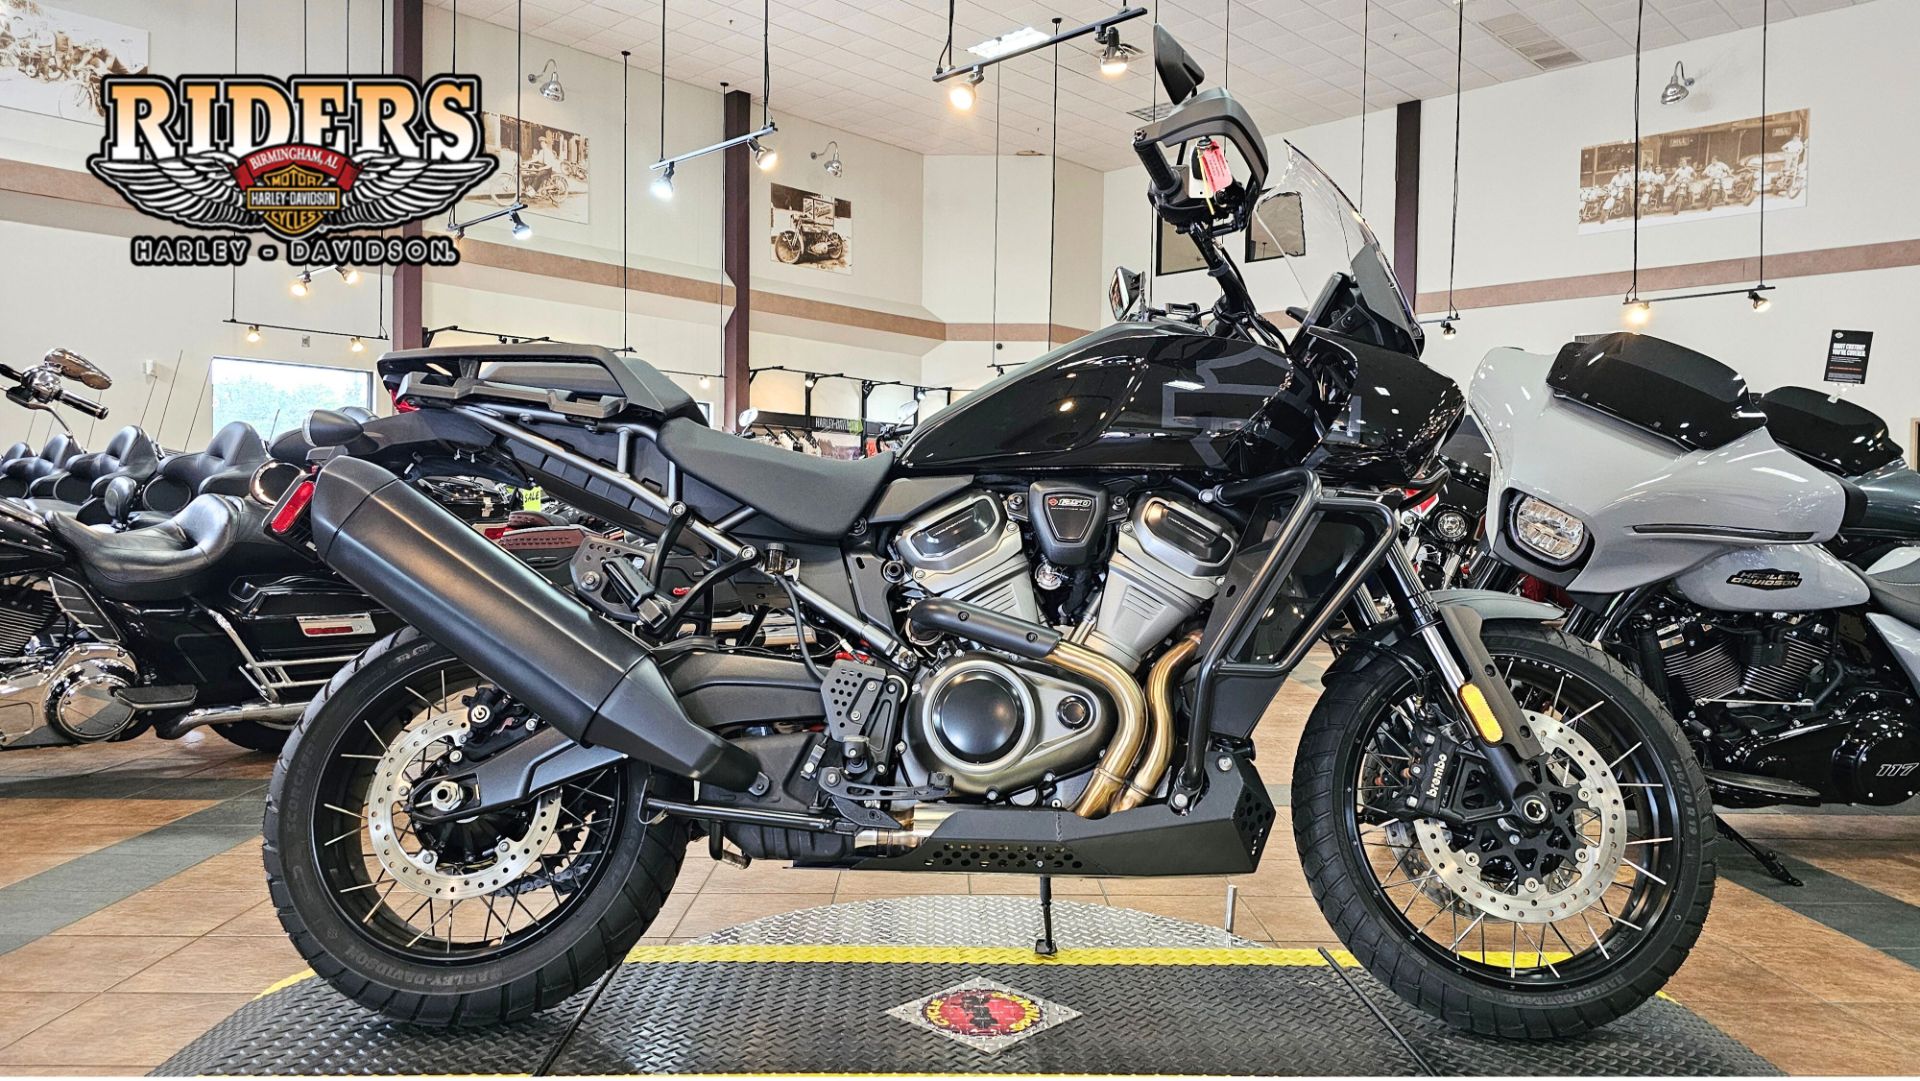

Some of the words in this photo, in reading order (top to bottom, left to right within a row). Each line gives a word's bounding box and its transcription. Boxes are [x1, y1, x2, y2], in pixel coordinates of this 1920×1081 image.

[524, 491, 540, 503] SALE
[1730, 577, 1799, 586] DAVIDSON
[1426, 753, 1447, 797] brembo
[1875, 762, 1919, 777] 117
